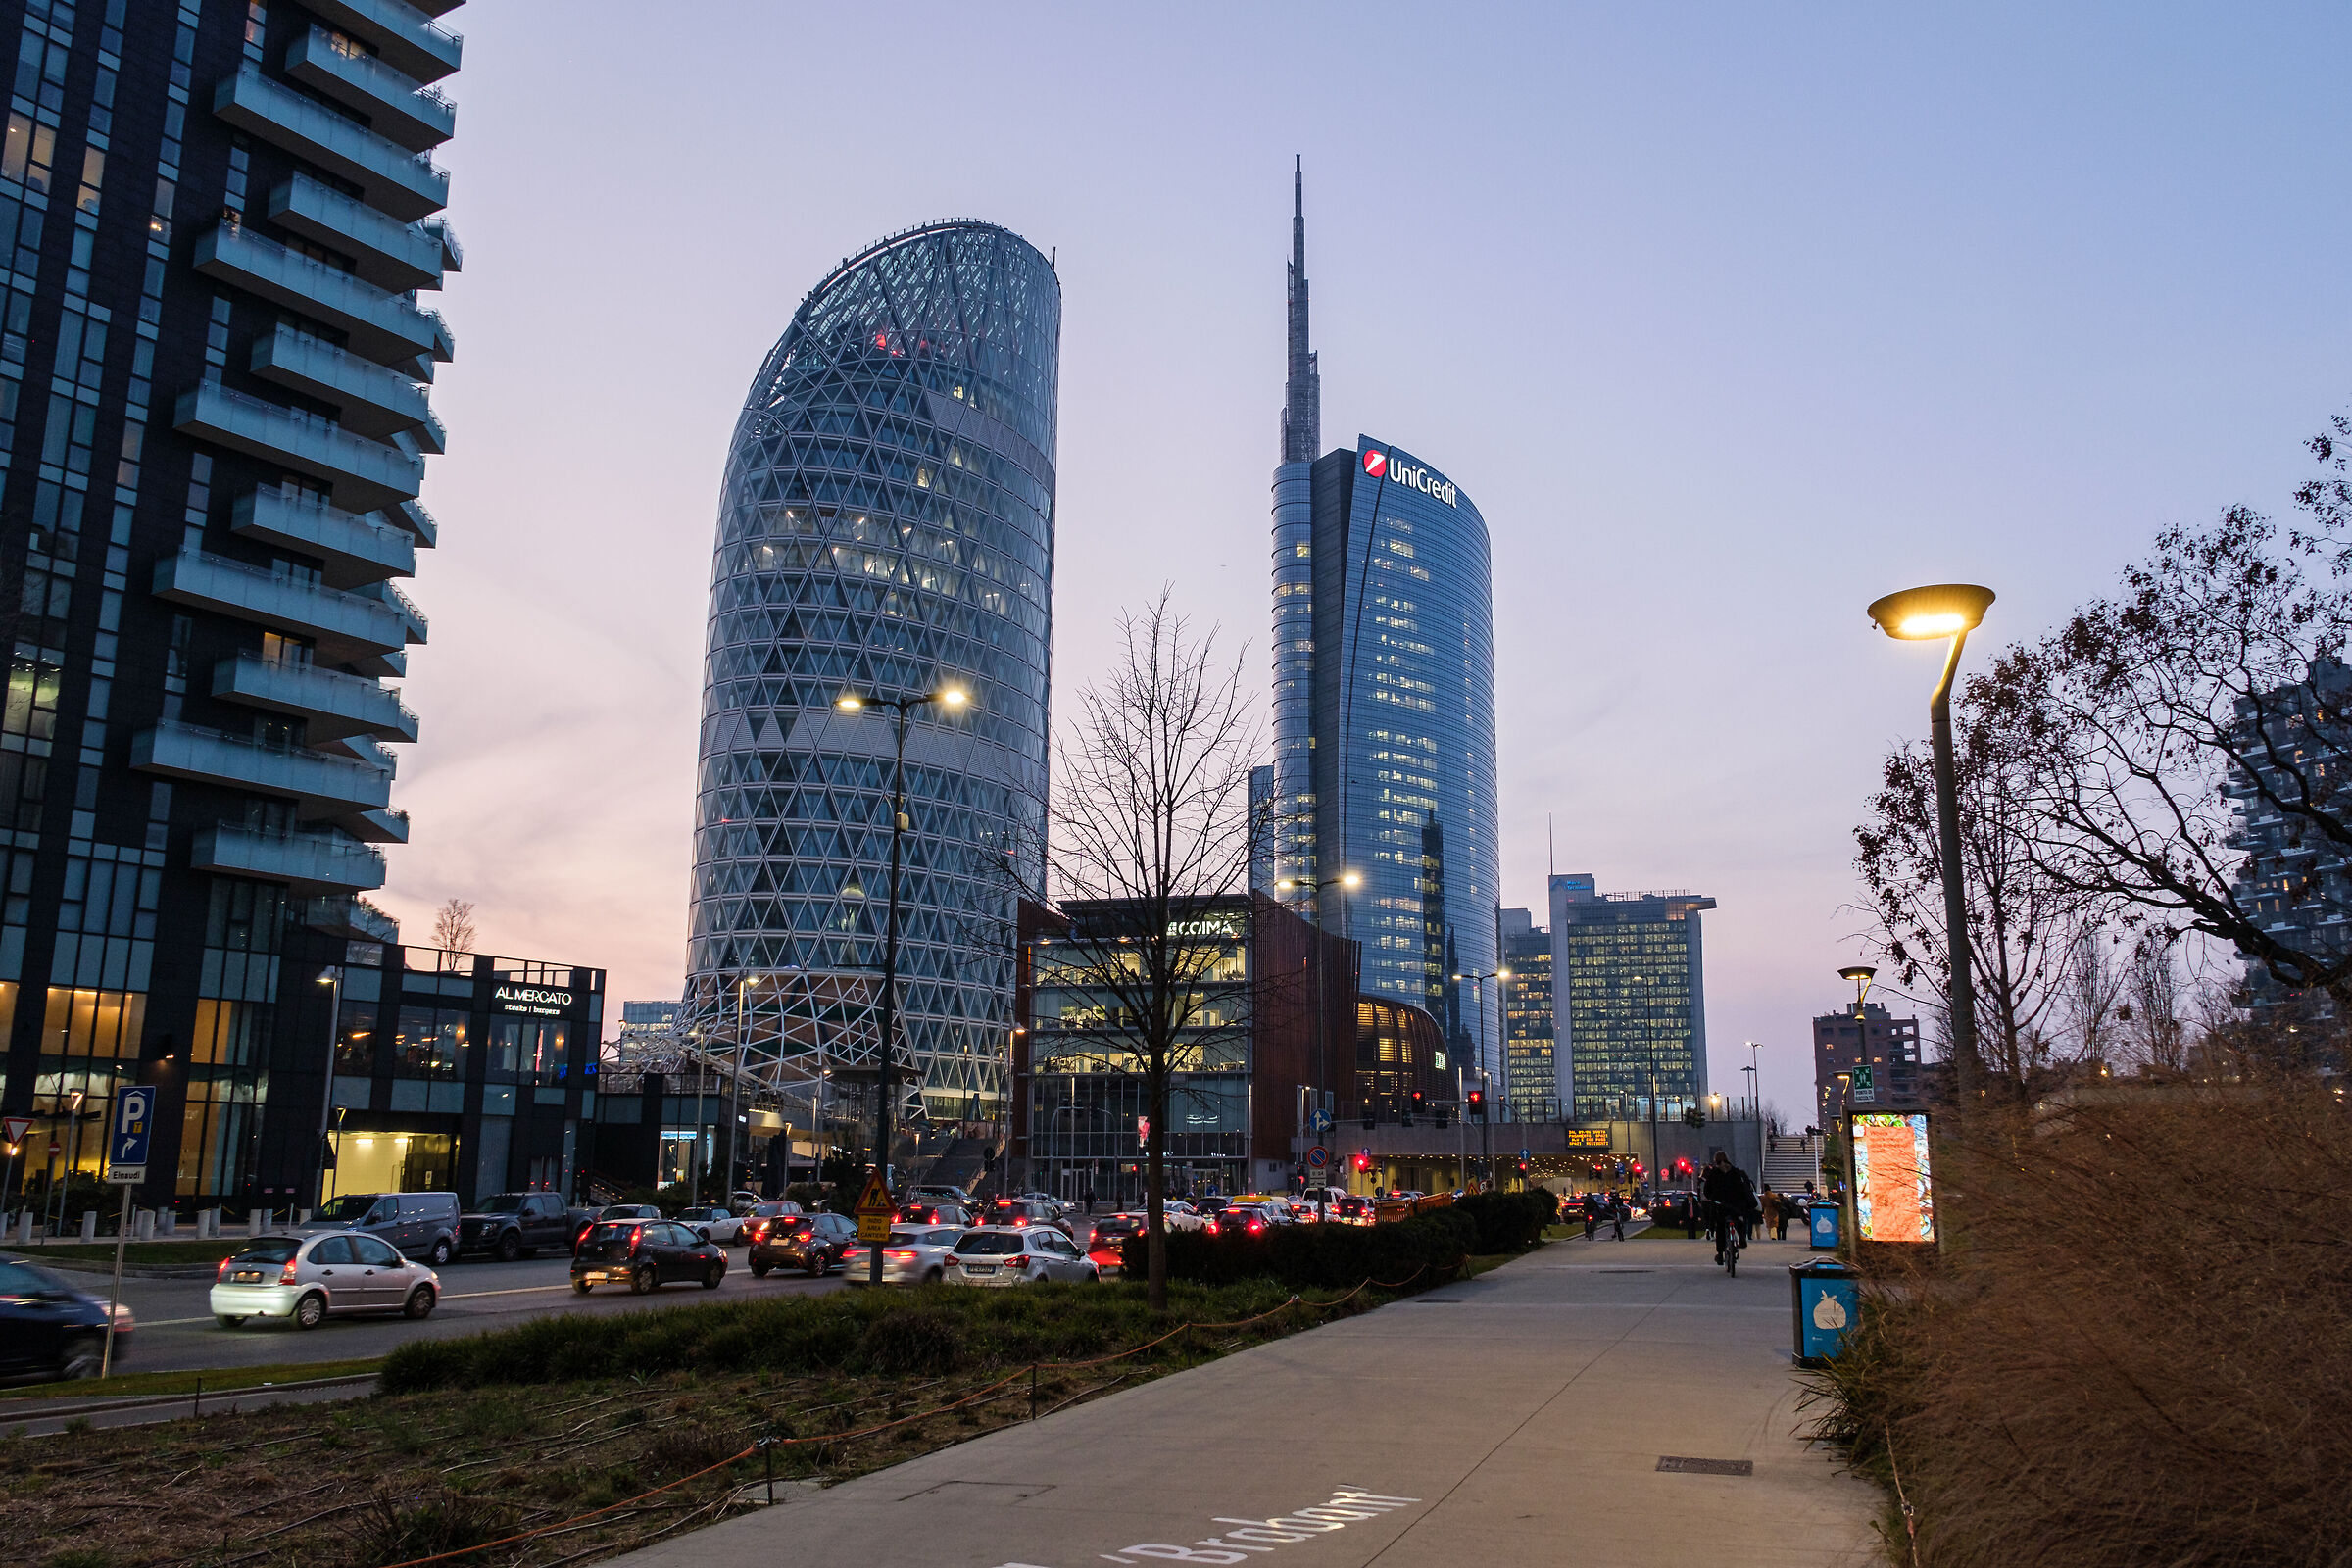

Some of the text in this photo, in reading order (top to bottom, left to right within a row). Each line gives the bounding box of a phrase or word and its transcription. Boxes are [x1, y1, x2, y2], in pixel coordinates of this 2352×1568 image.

[1389, 457, 1457, 509] UniCredit
[1178, 920, 1234, 936] COIMA
[495, 986, 572, 1005] AL MERCATO
[504, 1004, 527, 1012] steaks
[533, 1005, 561, 1015] burgers
[121, 1096, 145, 1134] P
[113, 1171, 141, 1180] Einaudi
